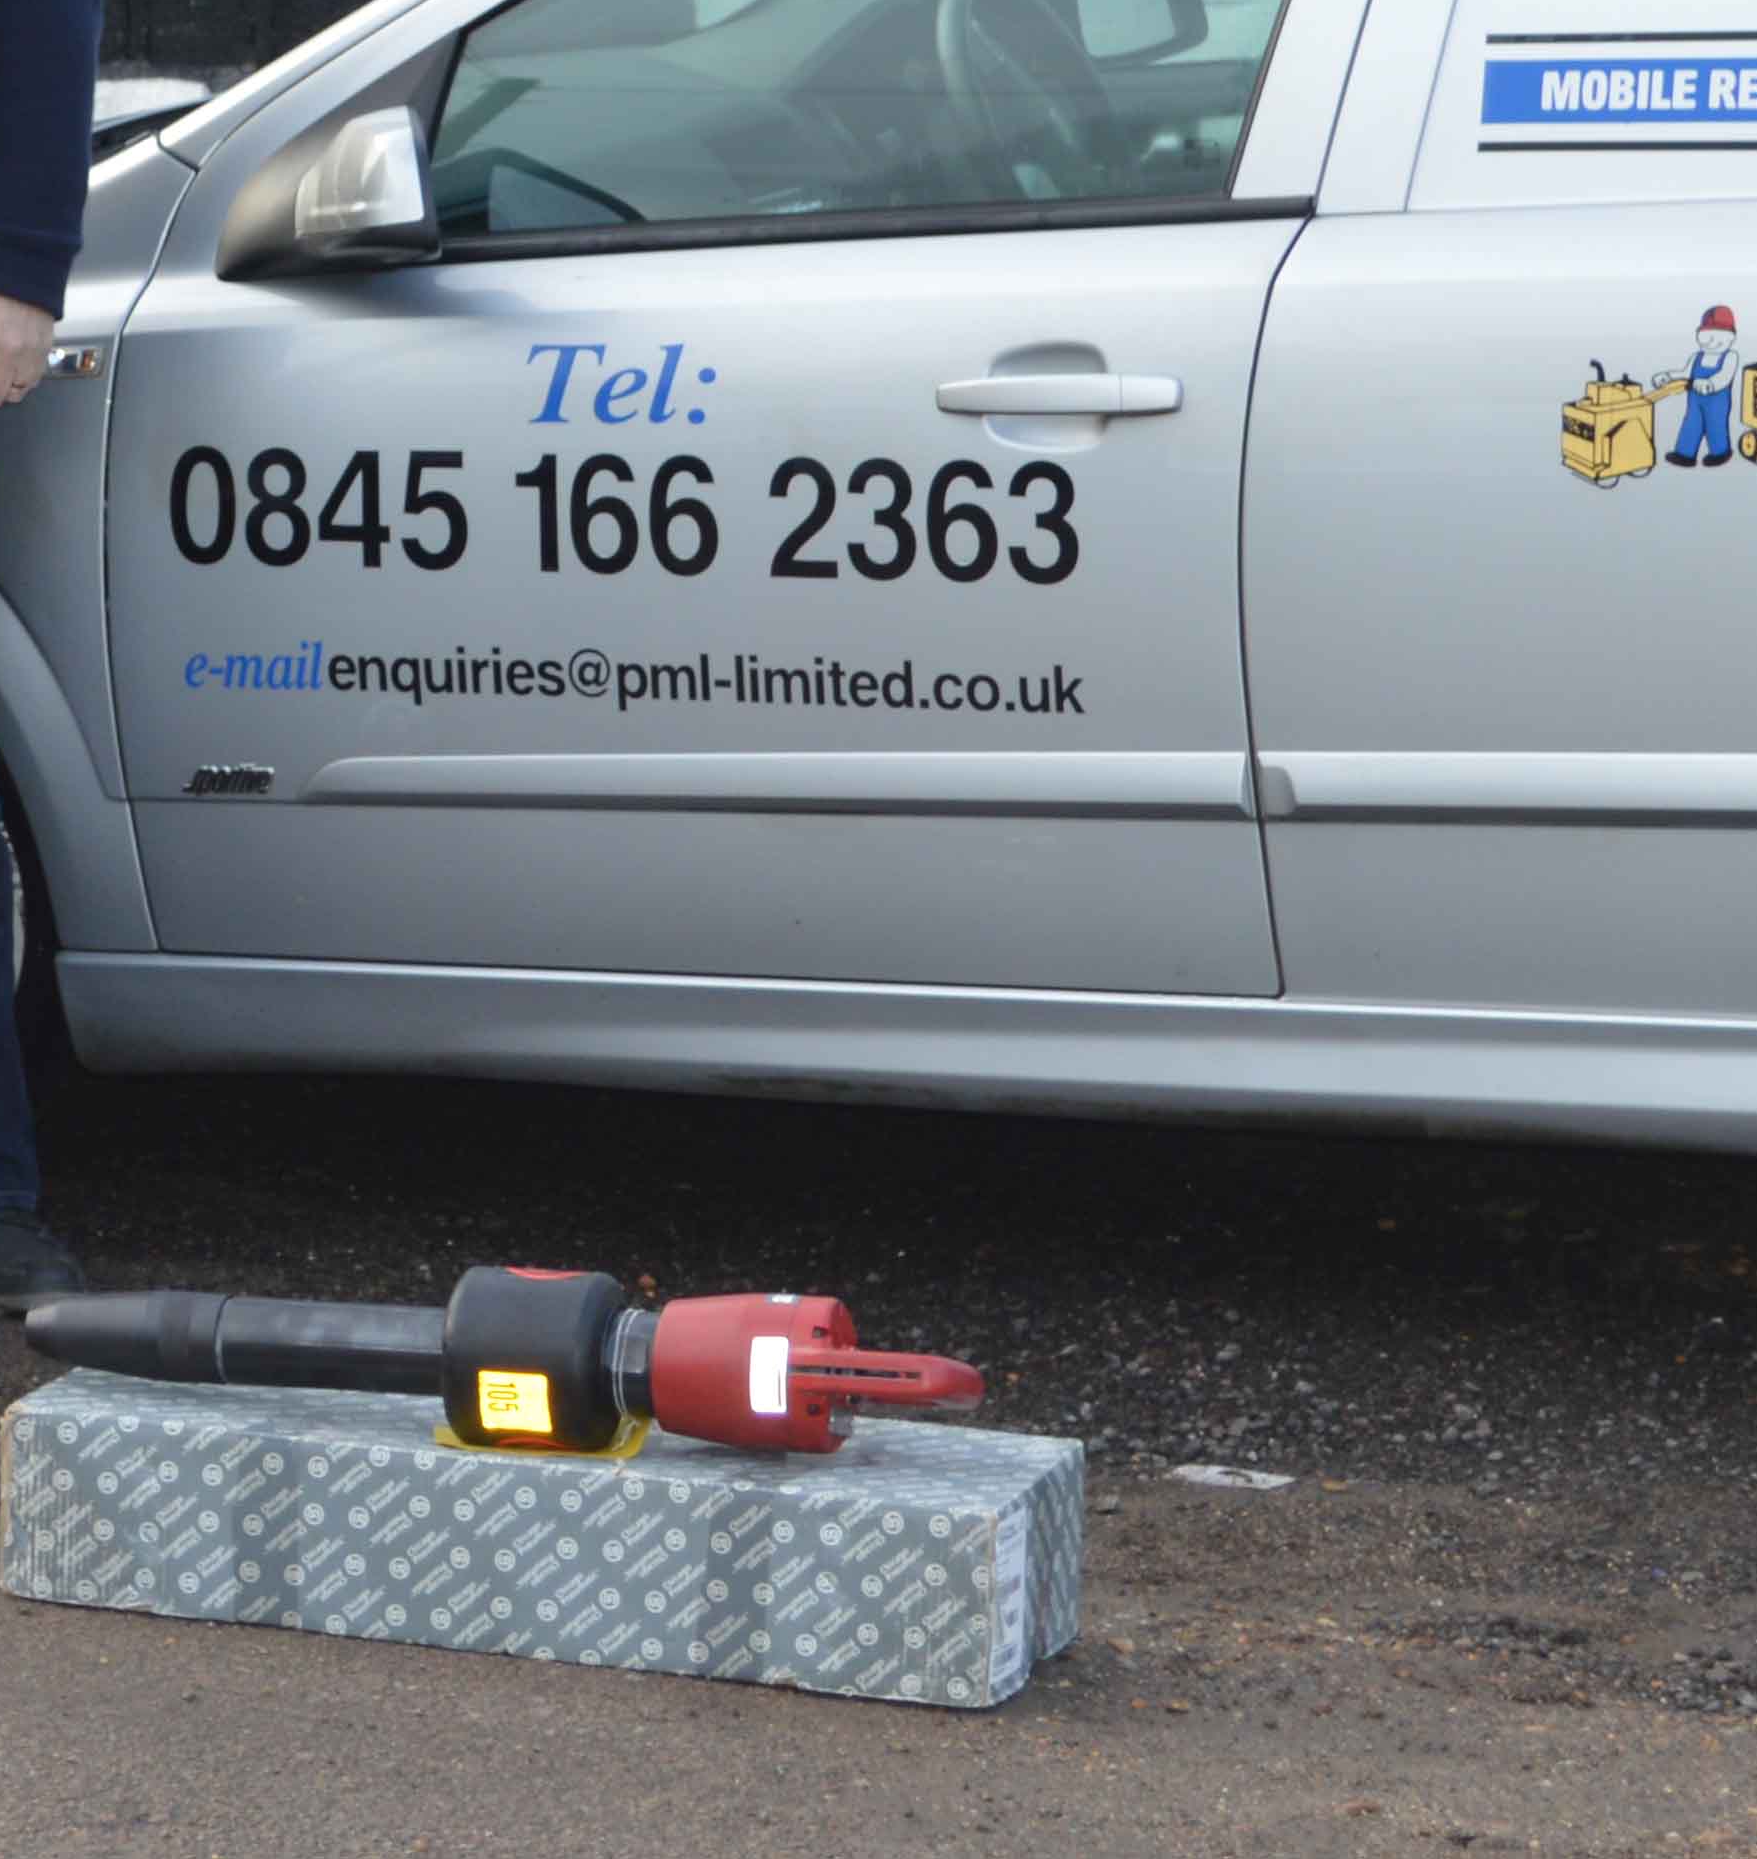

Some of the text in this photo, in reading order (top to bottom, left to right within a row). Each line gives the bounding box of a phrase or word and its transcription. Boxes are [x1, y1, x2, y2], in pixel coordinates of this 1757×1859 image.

[1541, 68, 1698, 111] MOBILE
[526, 343, 718, 425] Tel:
[169, 444, 1080, 586] 0845 166 2363
[184, 640, 1085, 714] e-mail enquiries@pml-limited.co.uk
[487, 1382, 520, 1413] 105
